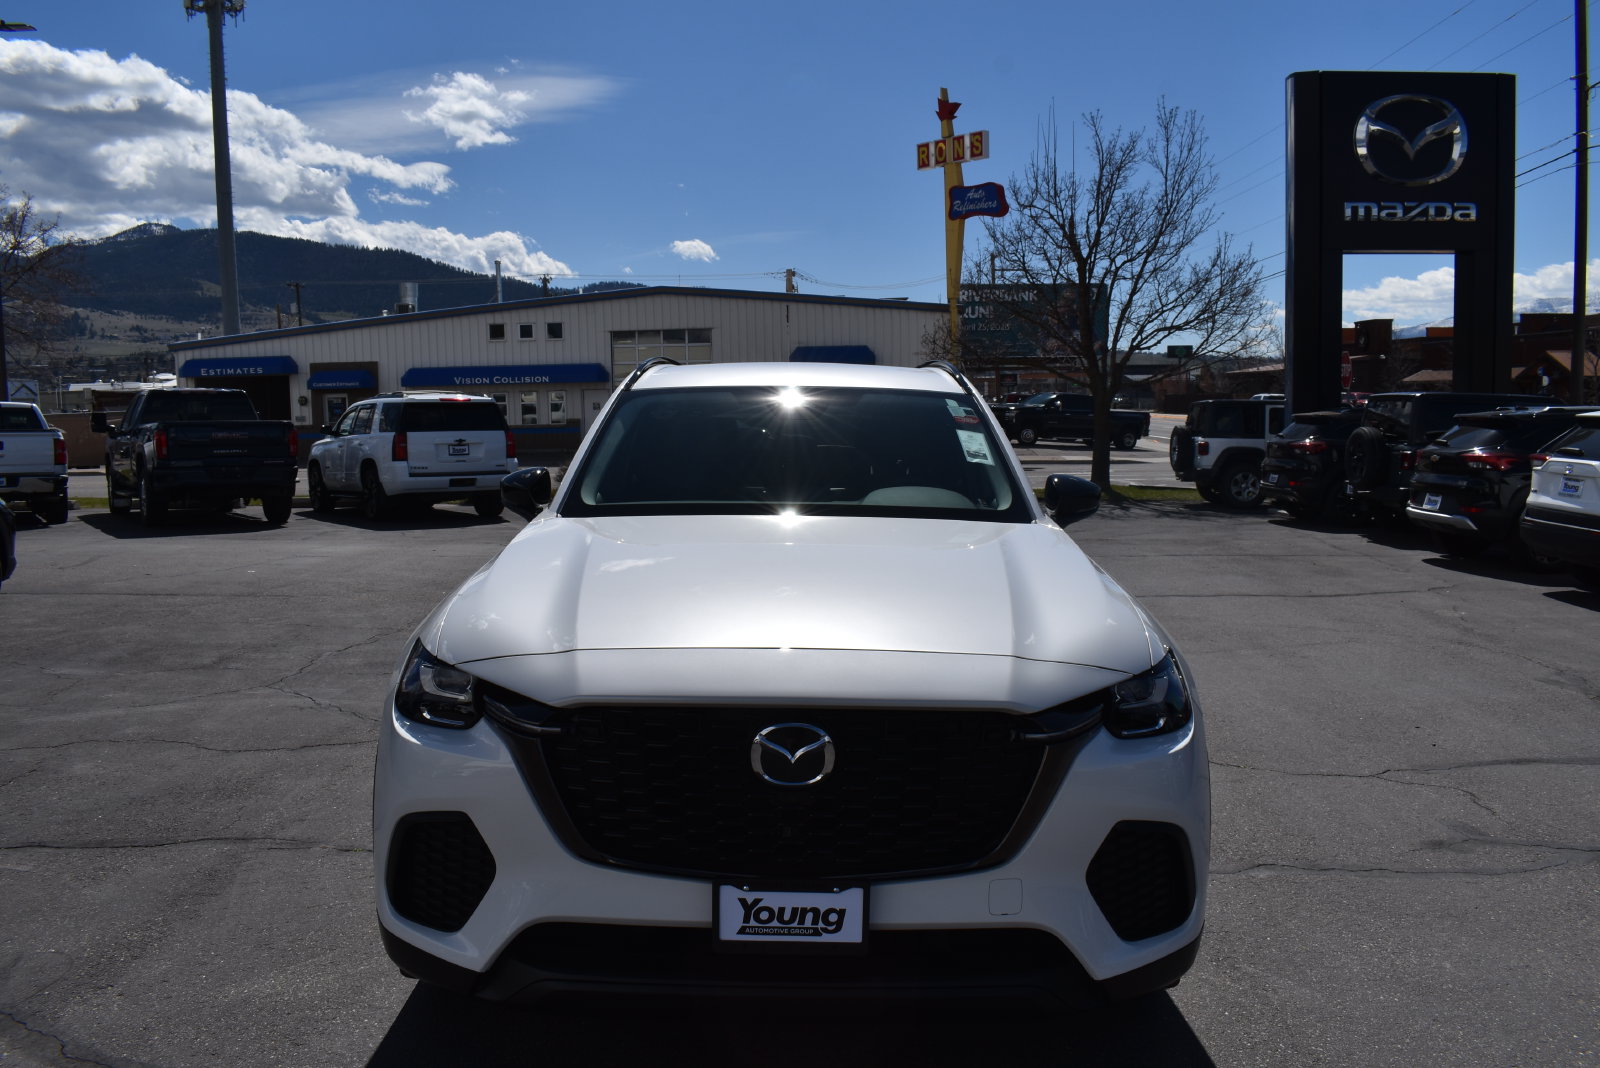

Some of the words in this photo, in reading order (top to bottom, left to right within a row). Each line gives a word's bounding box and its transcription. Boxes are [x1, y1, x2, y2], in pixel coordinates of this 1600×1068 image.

[965, 188, 985, 200] Auto
[953, 199, 998, 214] Refinishers
[737, 897, 846, 934] Young
[789, 927, 814, 935] GROUP
